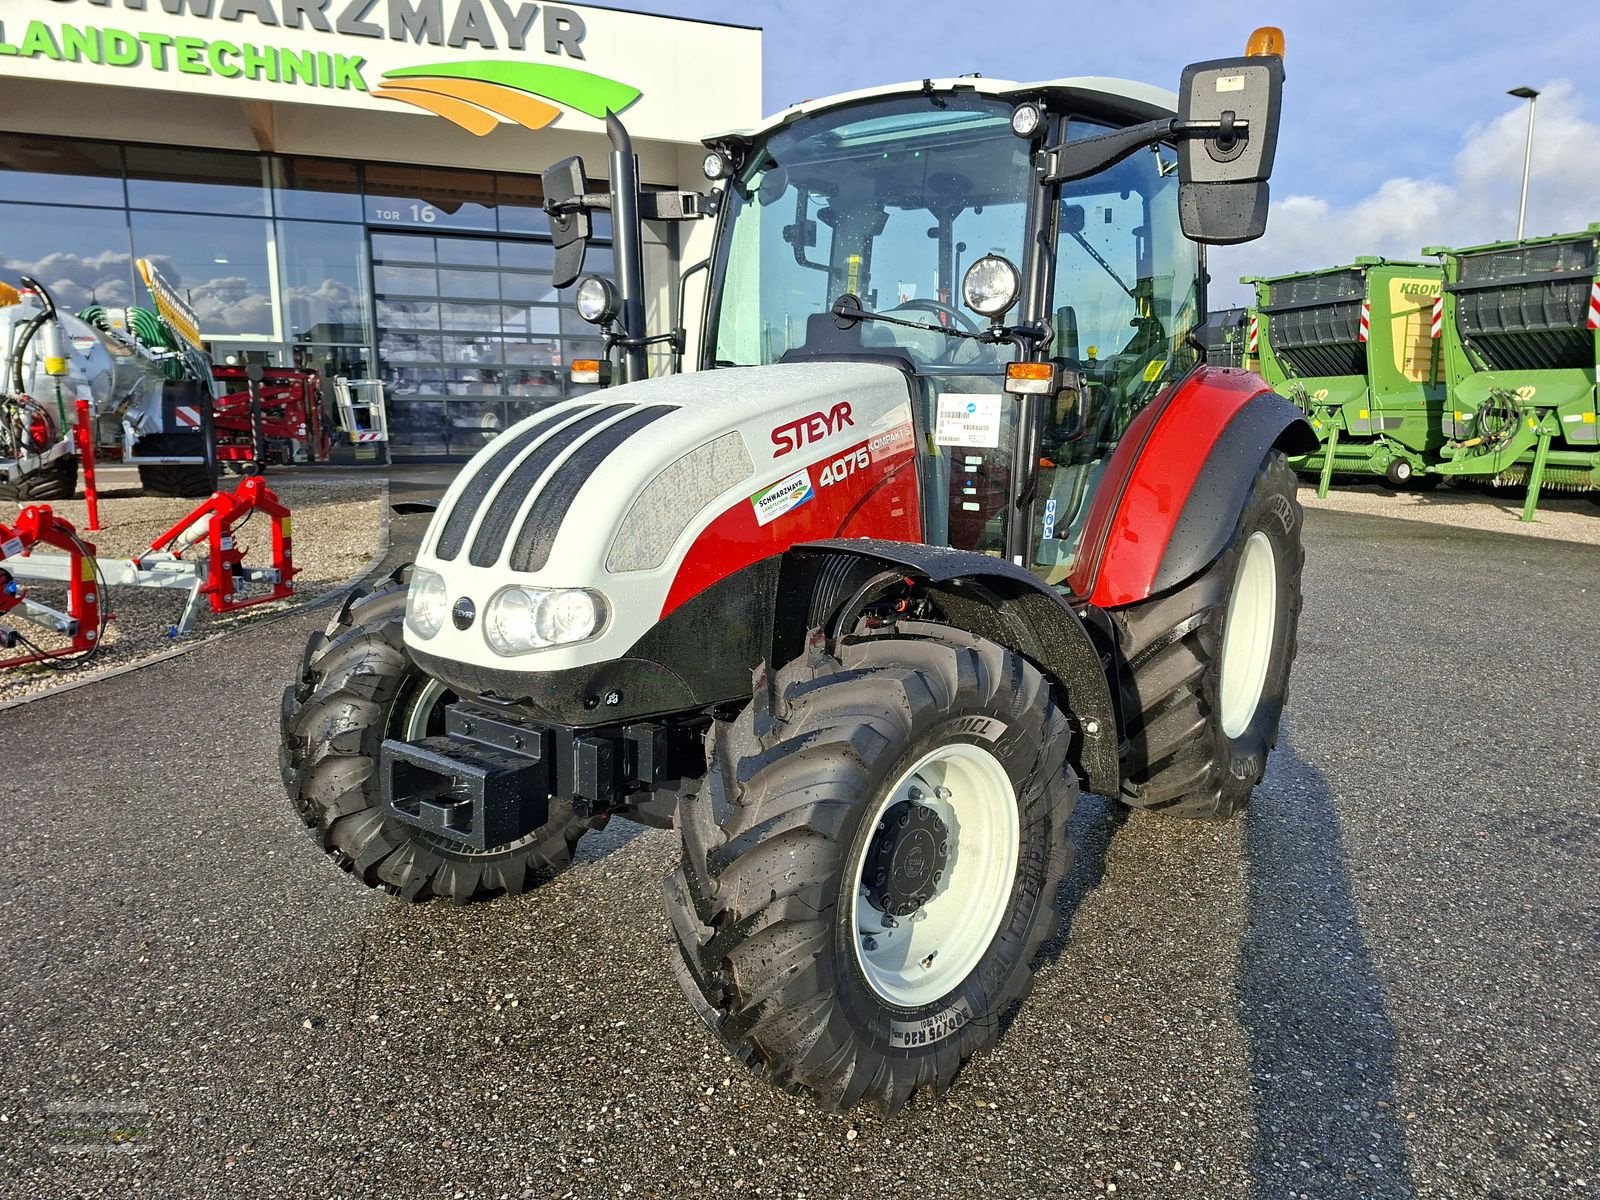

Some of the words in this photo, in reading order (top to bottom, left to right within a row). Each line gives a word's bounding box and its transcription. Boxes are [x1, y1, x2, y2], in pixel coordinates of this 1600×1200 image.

[376, 210, 400, 220] TOR
[410, 204, 436, 223] 16
[771, 401, 855, 458] STEYR
[819, 447, 870, 487] 4075
[867, 429, 904, 451] KOMPAKT
[758, 480, 803, 507] SCHWARZMAYR
